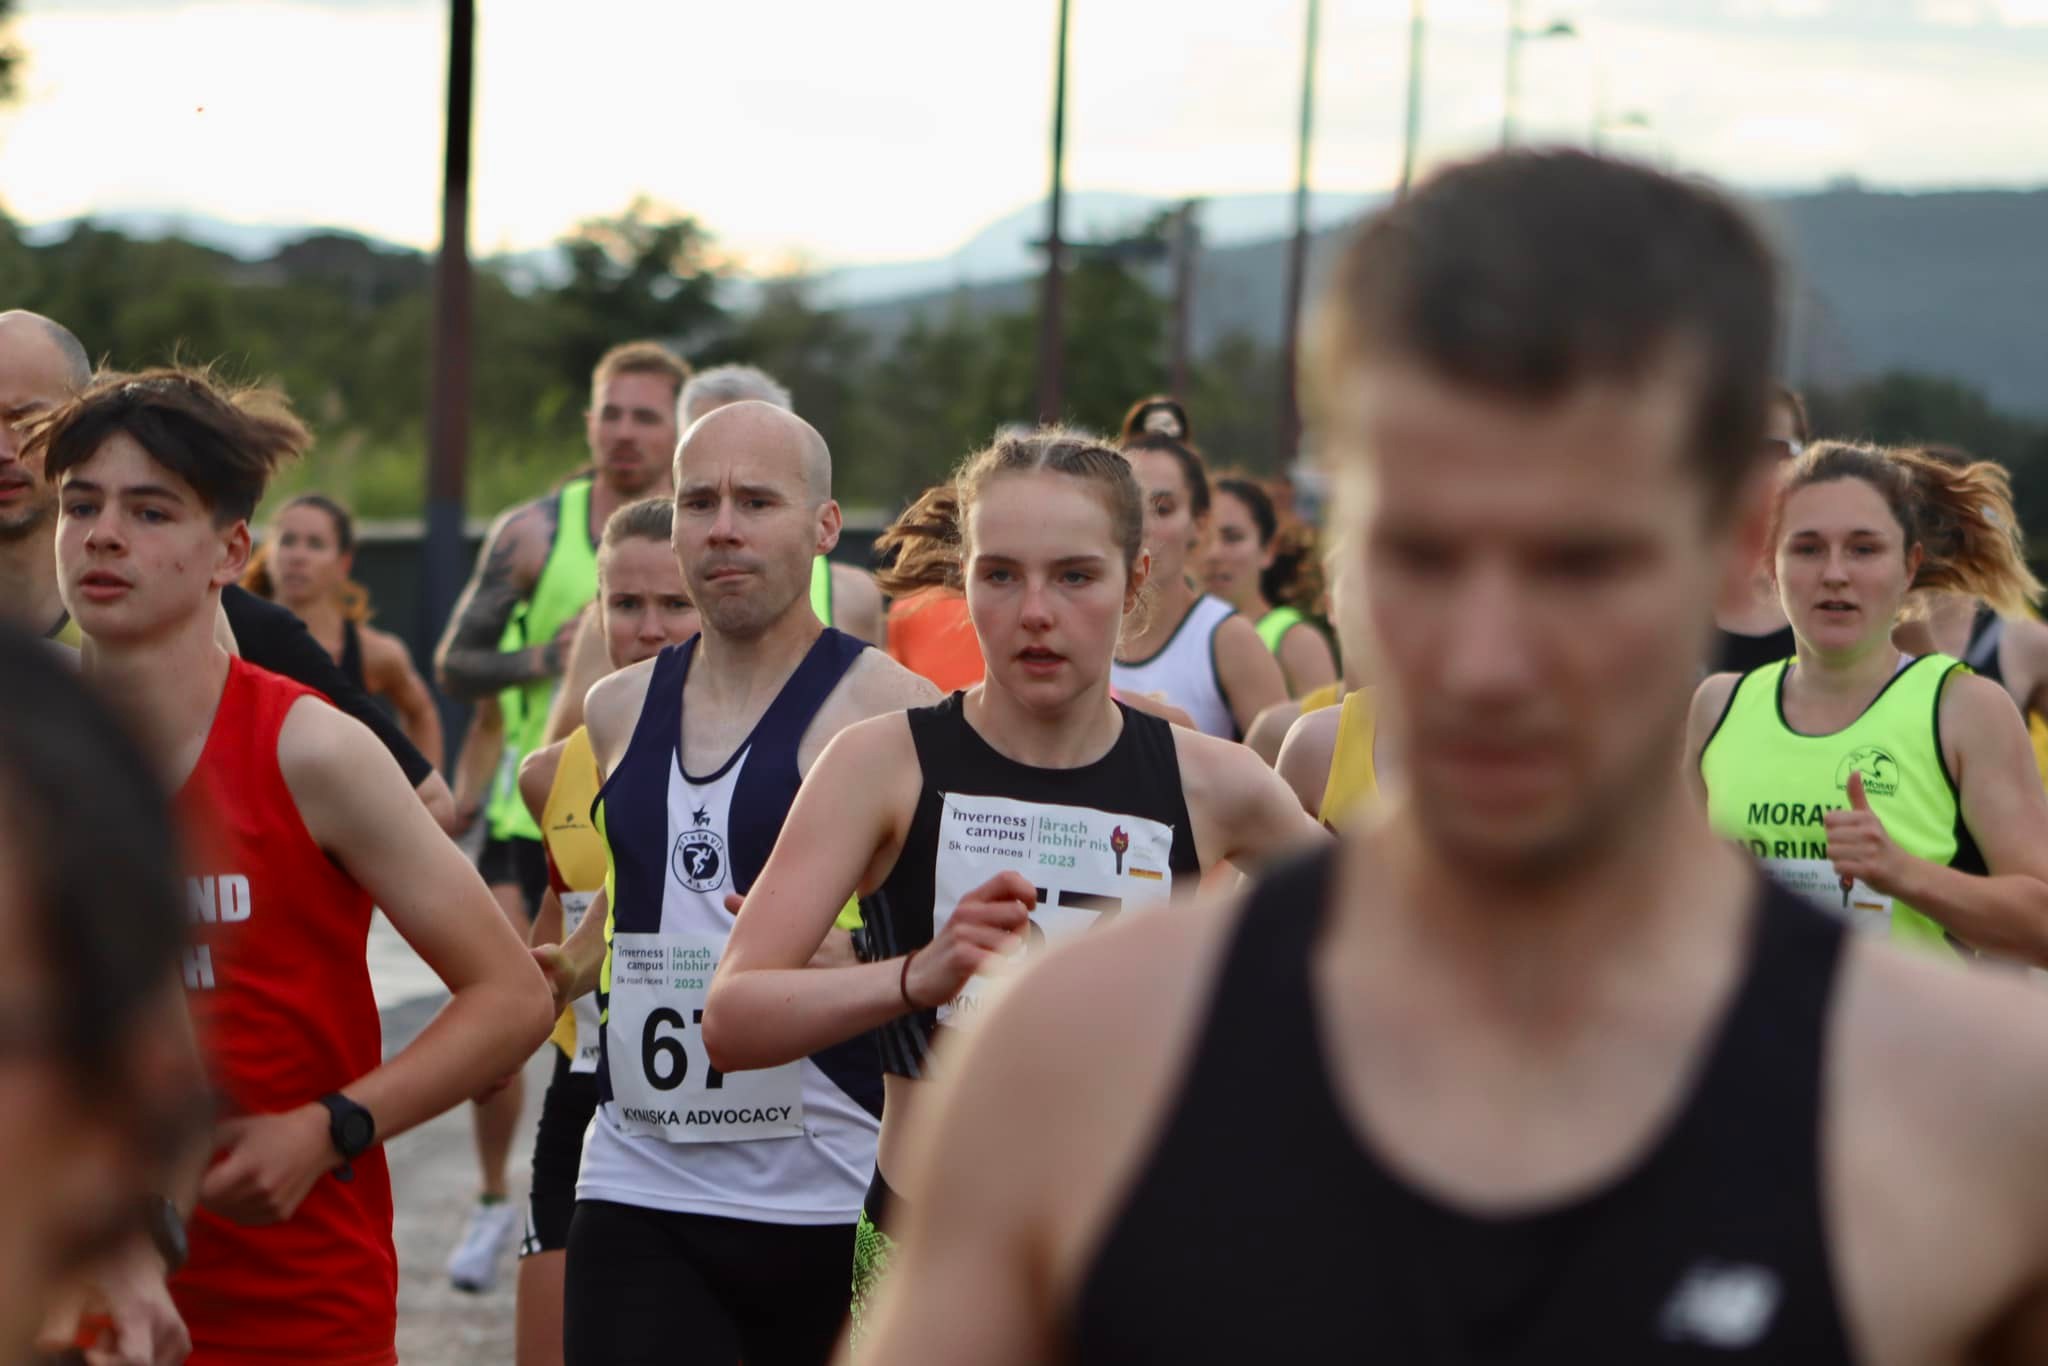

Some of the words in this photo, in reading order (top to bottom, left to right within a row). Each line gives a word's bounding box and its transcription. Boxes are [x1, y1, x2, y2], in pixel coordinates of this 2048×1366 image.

[953, 808, 1027, 827] inverness
[1747, 802, 1842, 827] MORA
[966, 827, 1025, 842] campus
[1038, 831, 1087, 849] inbhir
[964, 844, 990, 854] road
[992, 846, 1023, 858] races
[1039, 853, 1076, 868] 2023
[626, 960, 664, 972] campus
[672, 960, 711, 971] inbhir
[674, 979, 704, 989] 2023
[622, 1107, 680, 1126] KYNISKA
[685, 1106, 792, 1126] ADVOCACY
